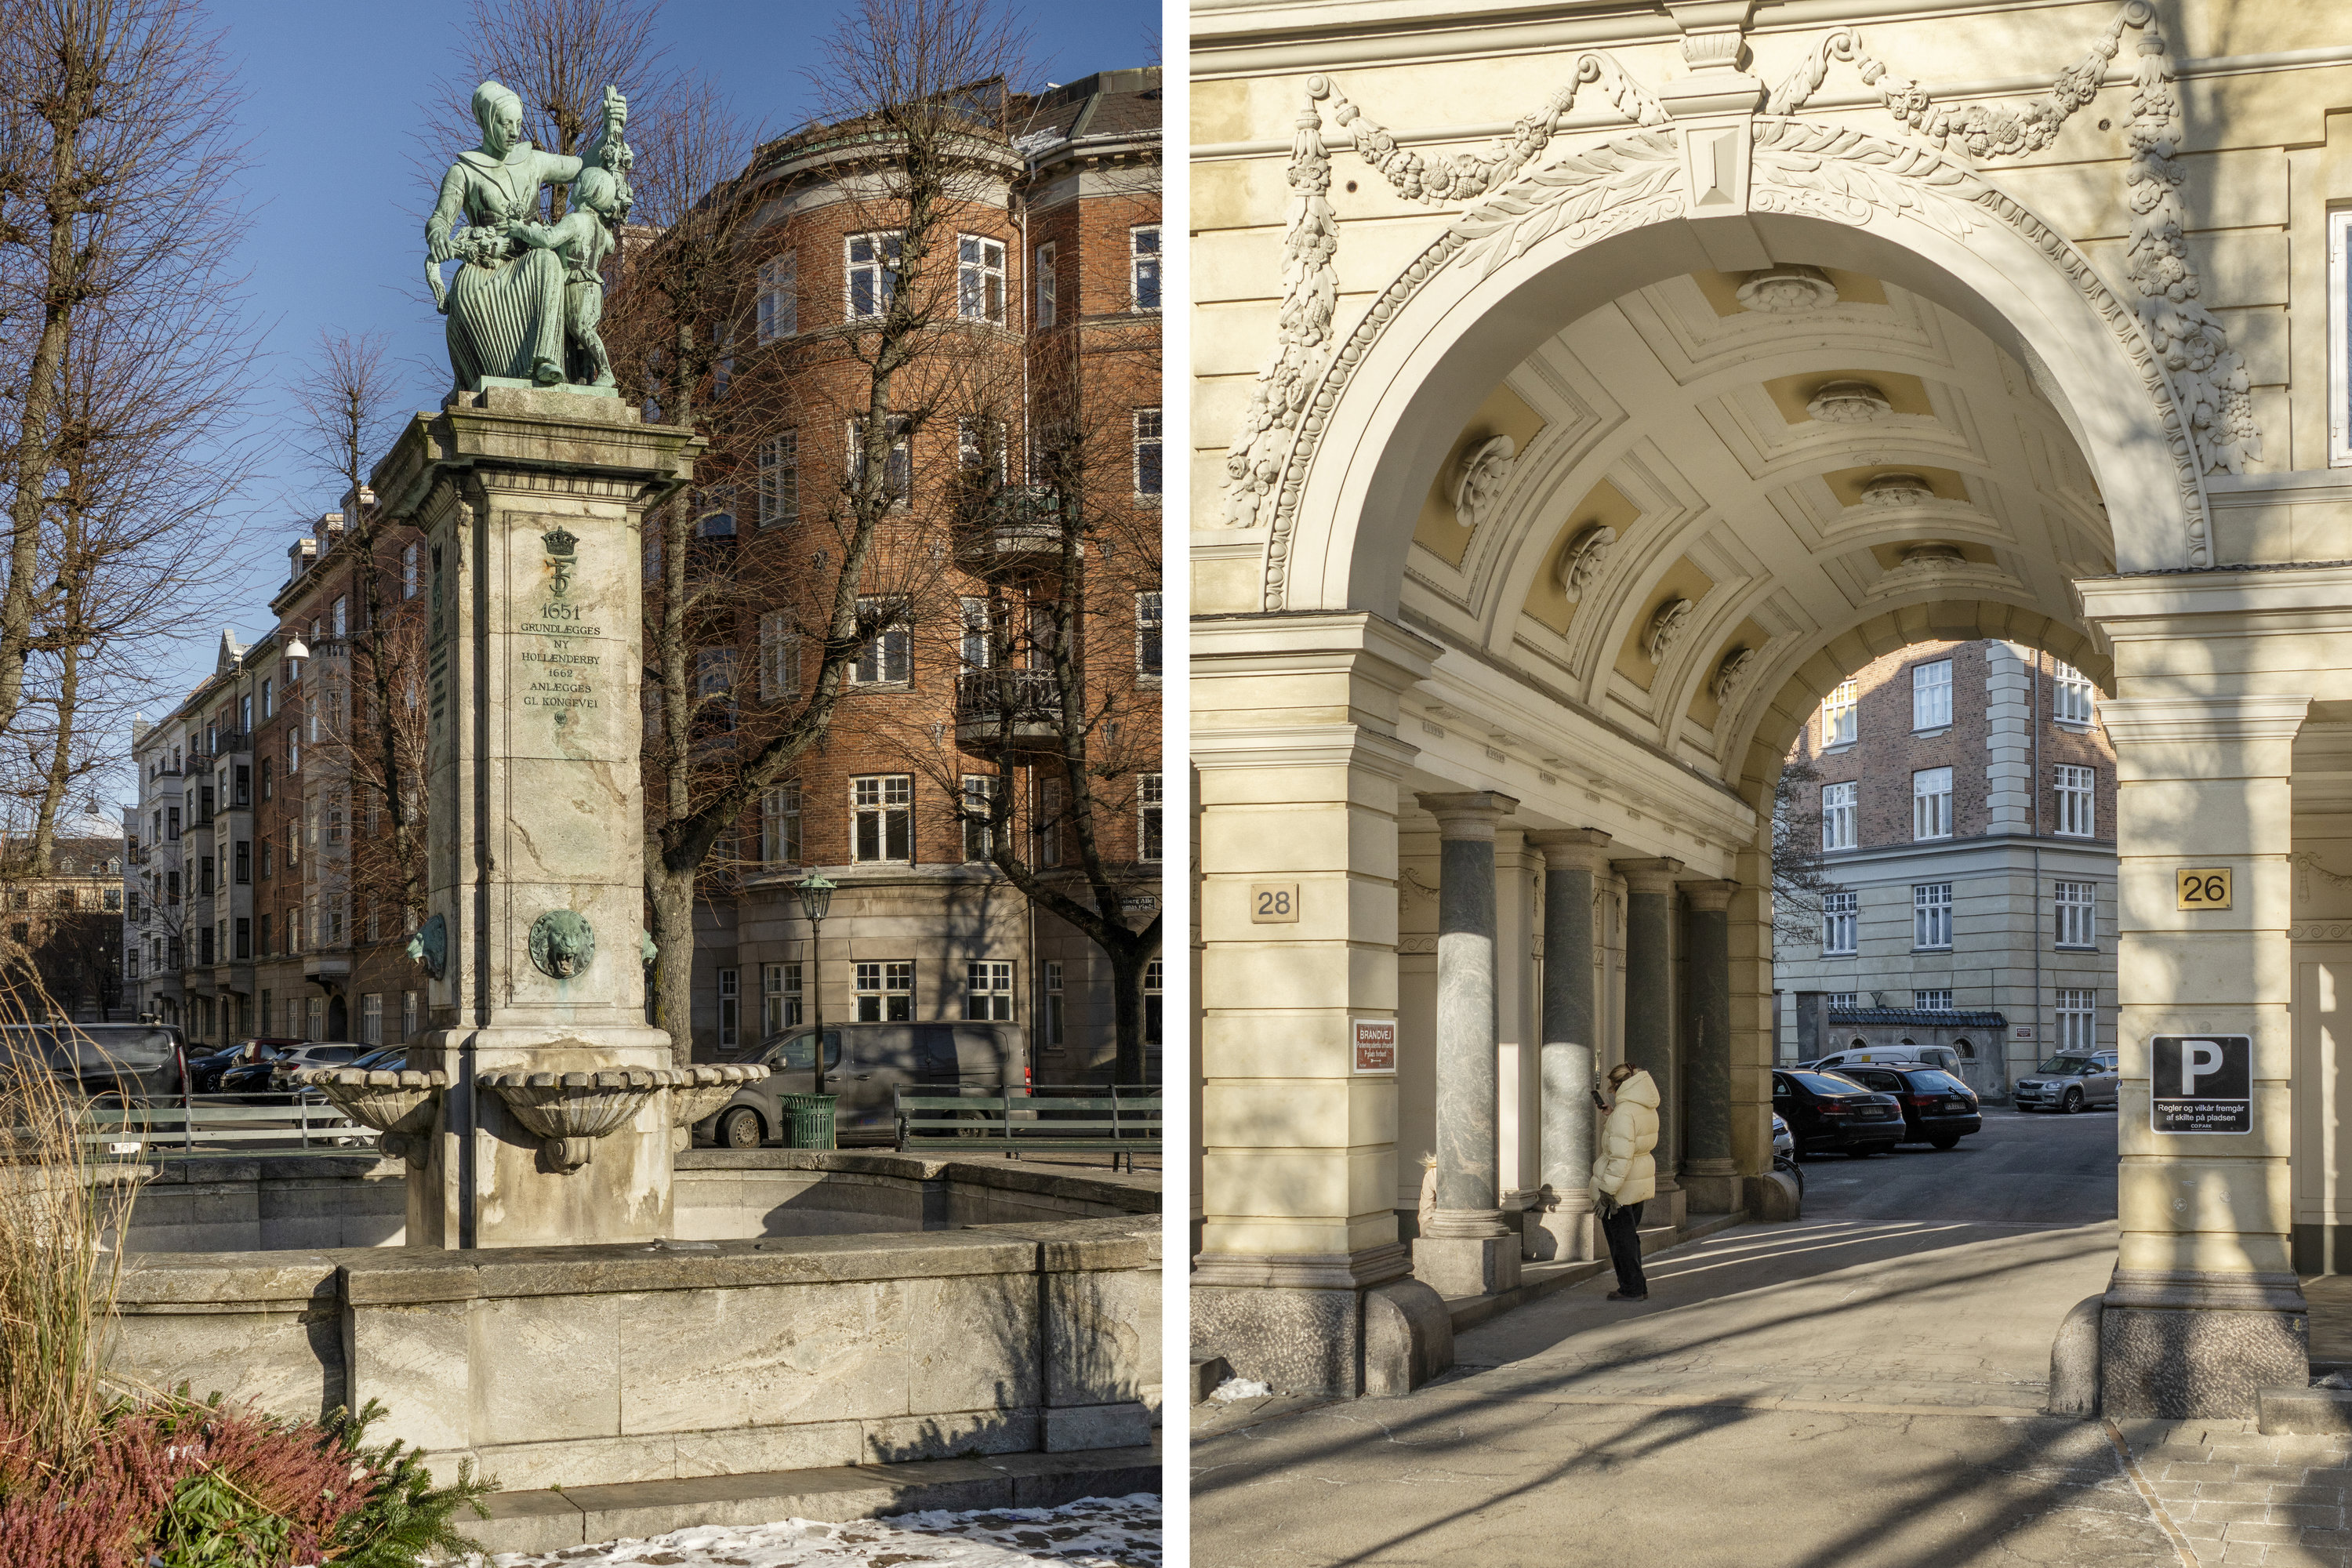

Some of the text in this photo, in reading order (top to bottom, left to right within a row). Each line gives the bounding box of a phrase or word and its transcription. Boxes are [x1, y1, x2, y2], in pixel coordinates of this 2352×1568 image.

[540, 602, 580, 620] 1651
[521, 622, 601, 636] GRUNDLÆGGES
[554, 640, 570, 649] NY
[521, 652, 600, 665] HOLLÆNDERBY
[549, 668, 573, 678] 1662
[530, 682, 592, 693] ANLÆGGES
[524, 696, 539, 706] GL
[2183, 876, 2225, 902] 26
[1258, 891, 1290, 915] 28
[1359, 1030, 1391, 1040] BRANDVEJ
[2182, 1040, 2223, 1095] P
[2158, 1104, 2183, 1112] Regler
[2216, 1104, 2245, 1112] fremgår
